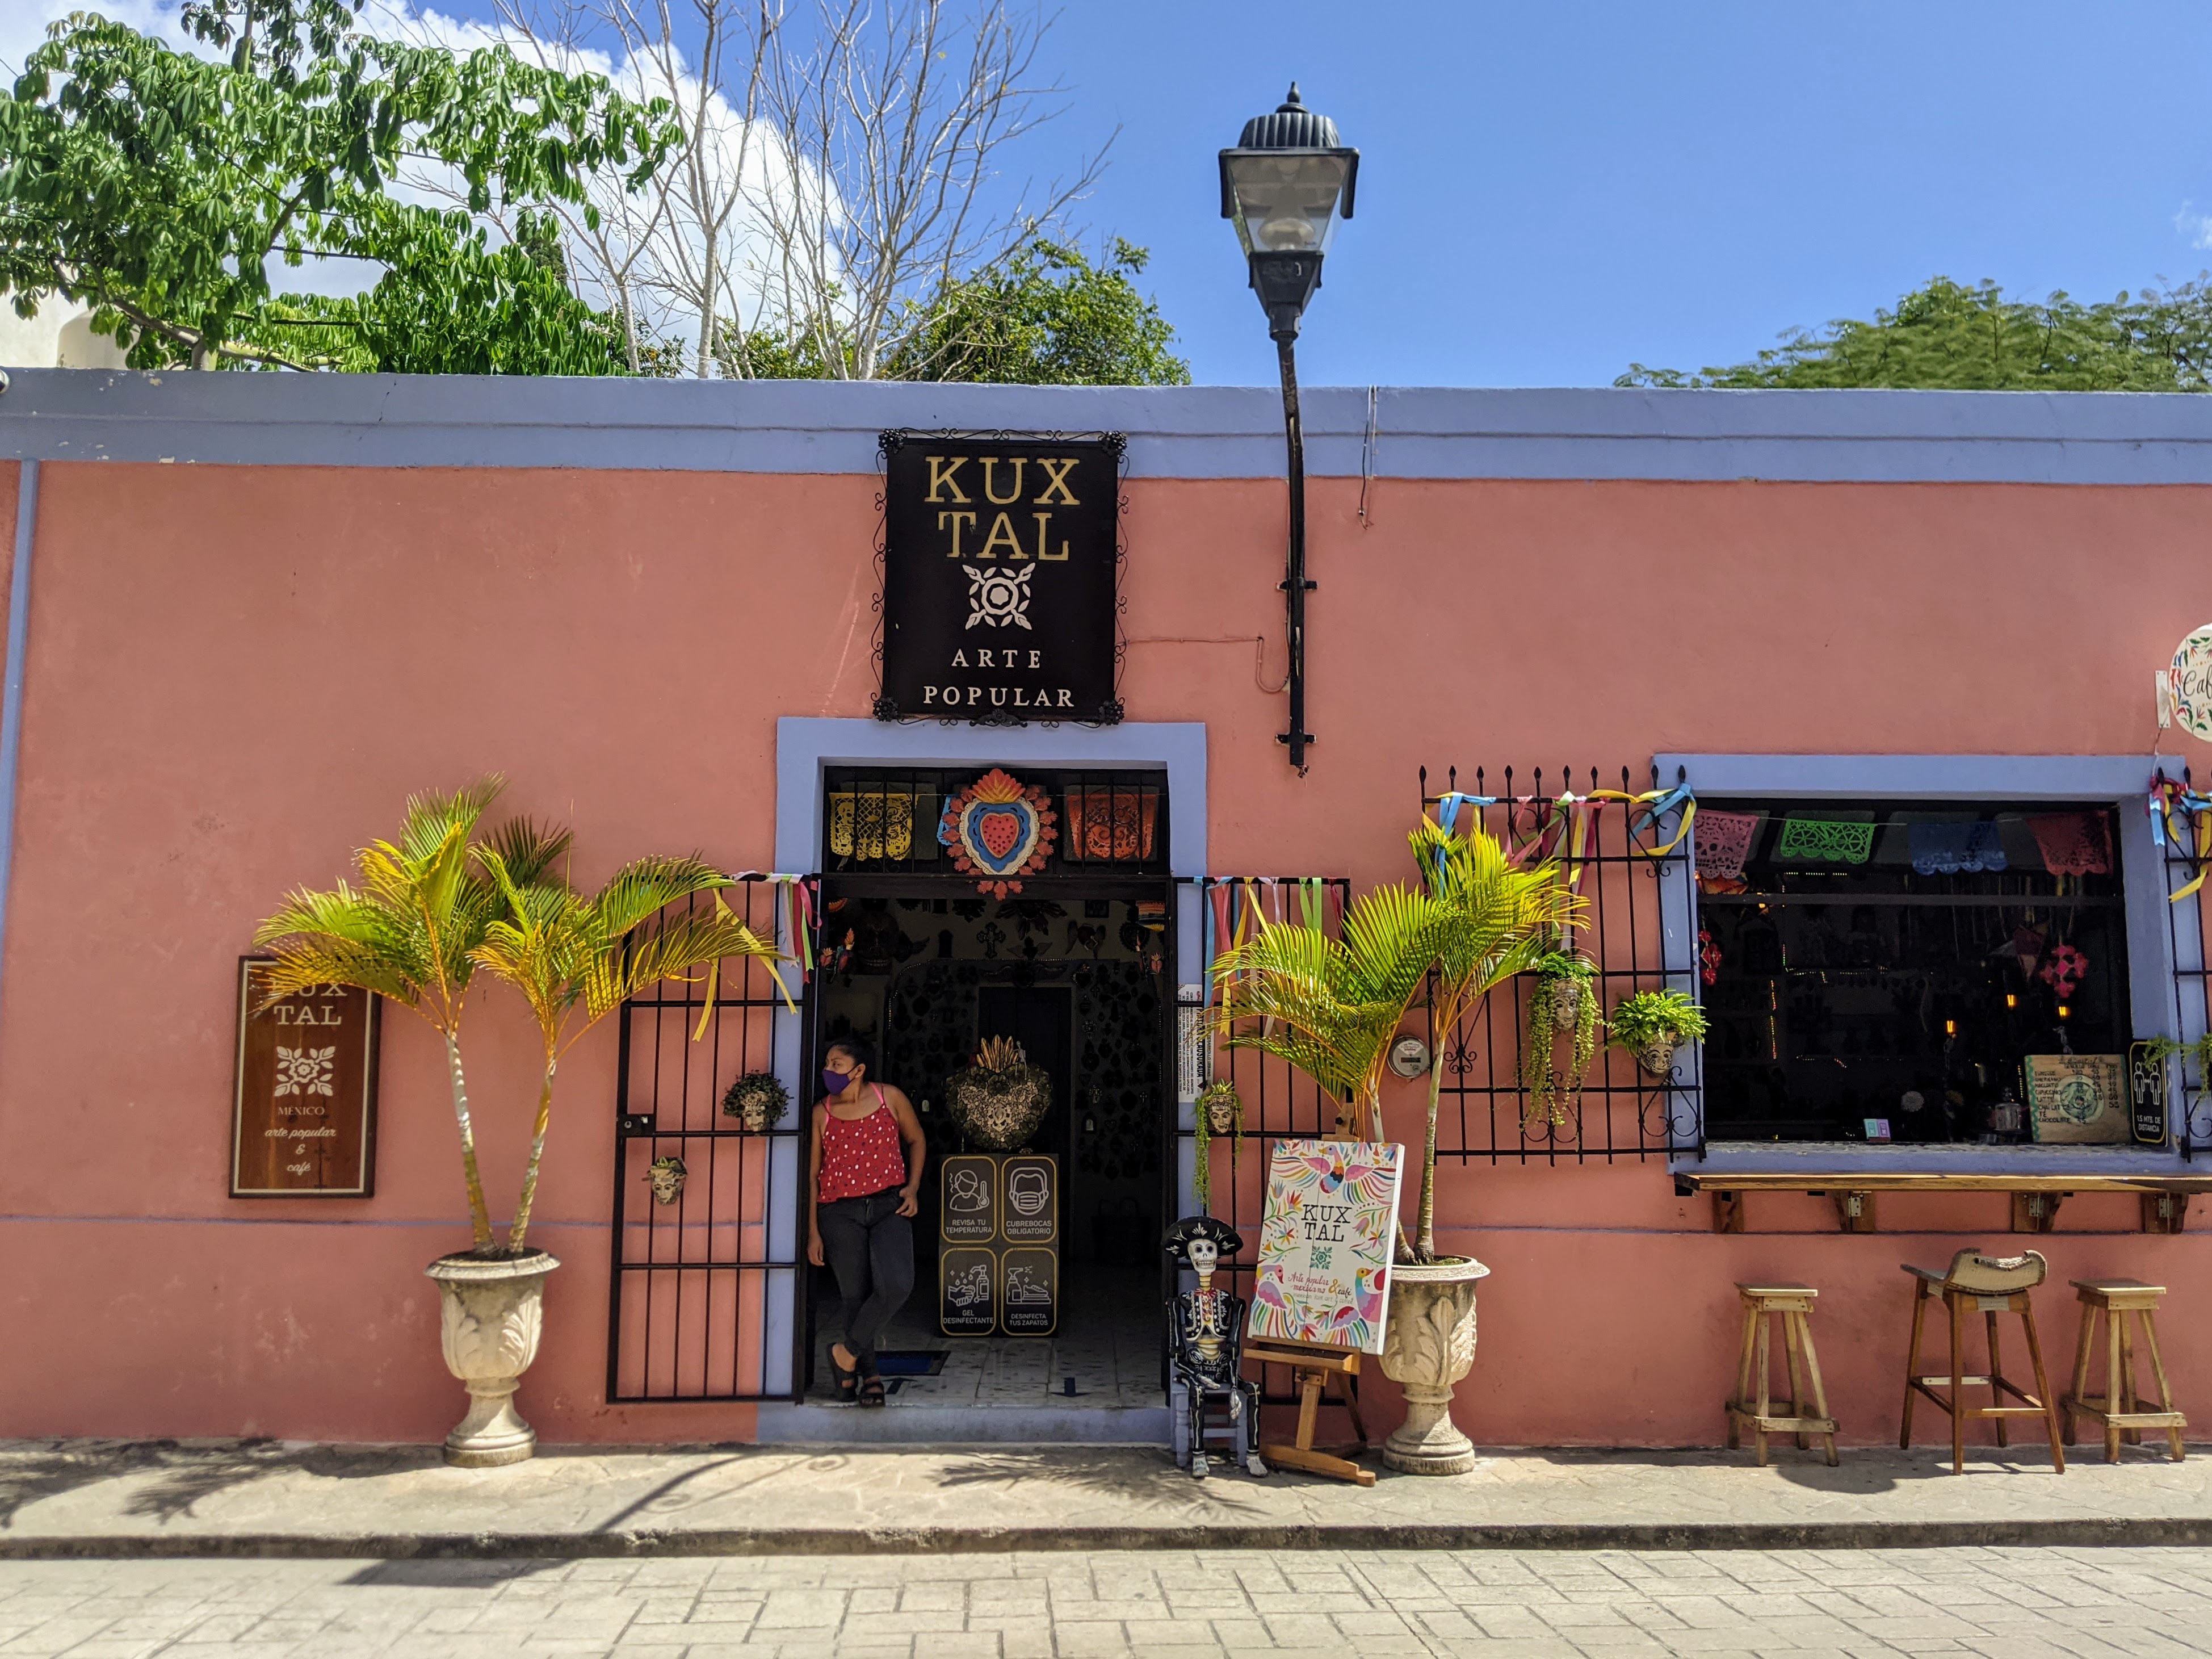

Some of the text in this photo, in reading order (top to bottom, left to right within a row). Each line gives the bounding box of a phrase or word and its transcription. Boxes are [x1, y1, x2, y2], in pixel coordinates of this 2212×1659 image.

[925, 456, 1080, 505] KUX
[938, 512, 1069, 561] TAL
[951, 648, 1041, 668] ARTE
[923, 686, 1074, 707] POPULAR
[274, 1006, 342, 1025] TAL
[265, 1126, 337, 1139] arte popular
[2138, 1124, 2160, 1133] DISTANCIA
[296, 1144, 305, 1155] &
[287, 1162, 311, 1175] café
[1301, 1204, 1352, 1224] KUX
[1304, 1222, 1344, 1242] TAL
[1287, 1272, 1329, 1287] Arte popular
[1291, 1279, 1352, 1298] mexicano & café
